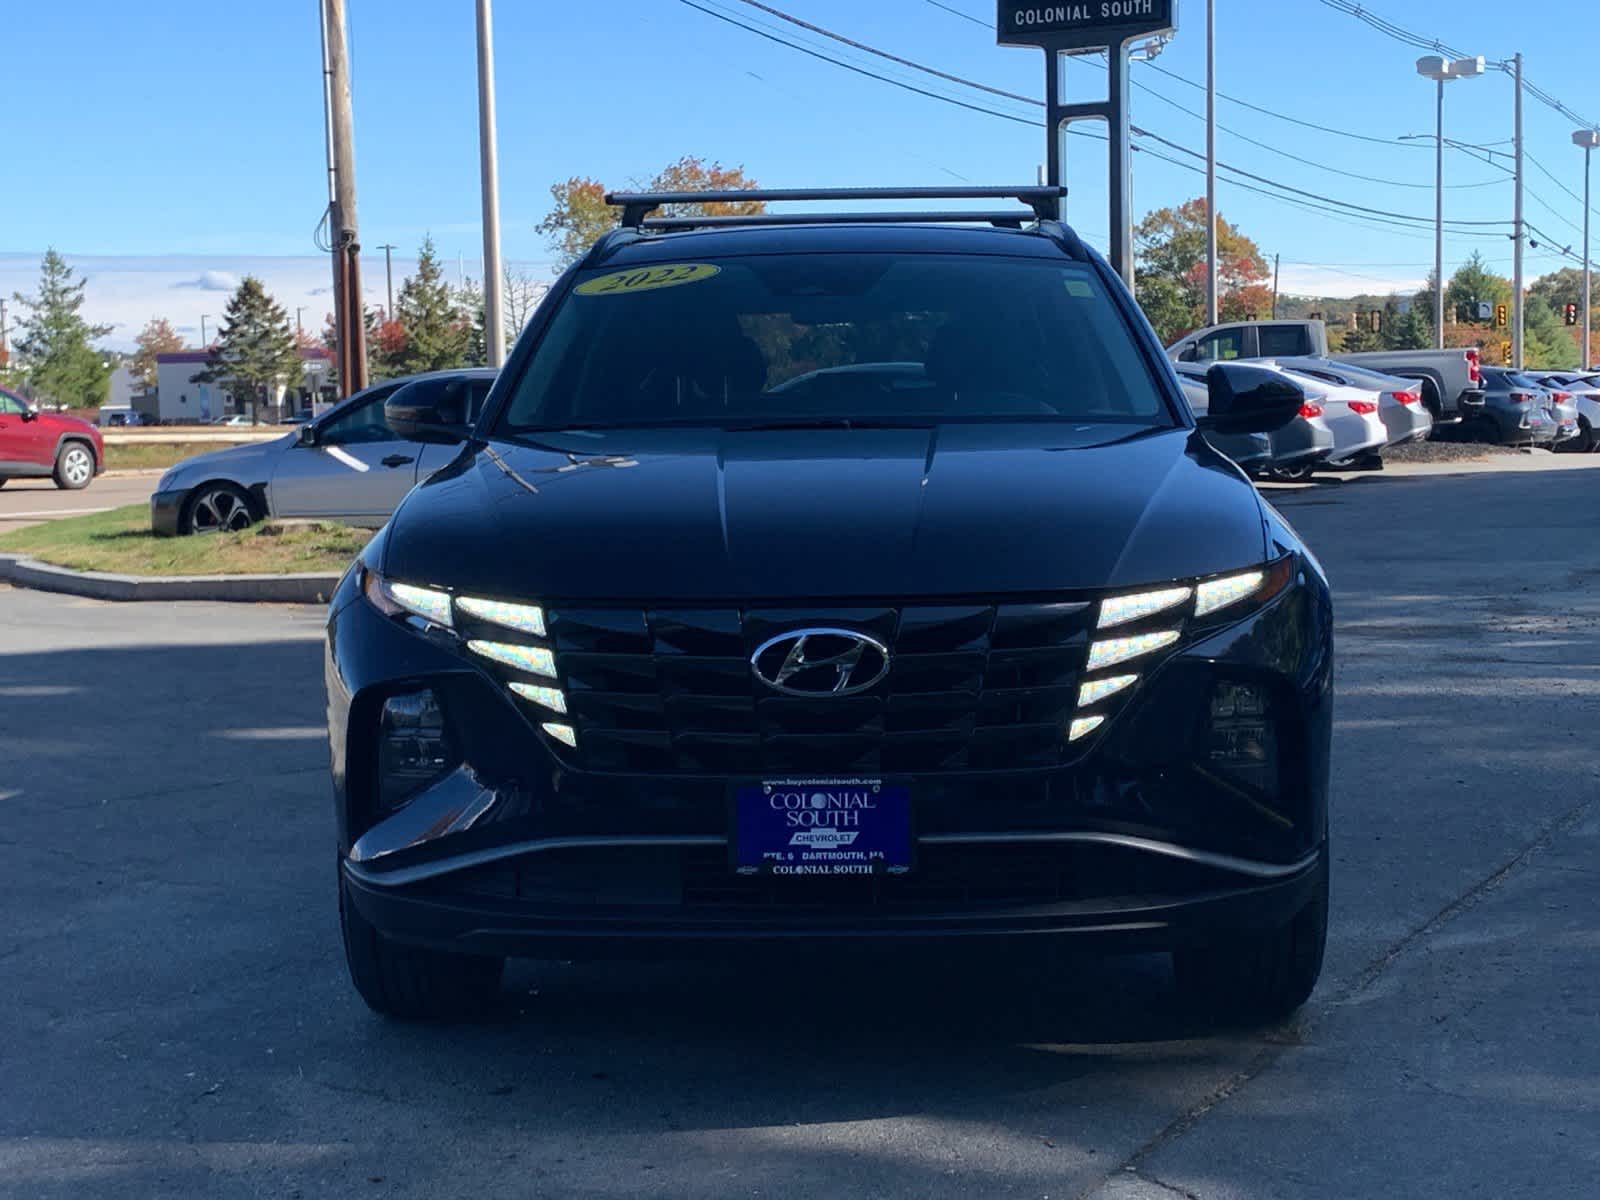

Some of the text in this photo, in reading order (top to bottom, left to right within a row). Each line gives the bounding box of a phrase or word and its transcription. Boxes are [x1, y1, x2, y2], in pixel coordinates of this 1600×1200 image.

[1015, 0, 1152, 25] COLONIAL SOUTH
[599, 265, 698, 291] 2022
[763, 777, 881, 787] www.buycolonialsouth.com
[770, 793, 876, 809] COLONIAL
[787, 810, 859, 826] SOUTH
[795, 834, 851, 843] CHEVROLET
[802, 851, 867, 861] DARTMOUTH,
[773, 864, 873, 874] COLONIAL SOUTH
